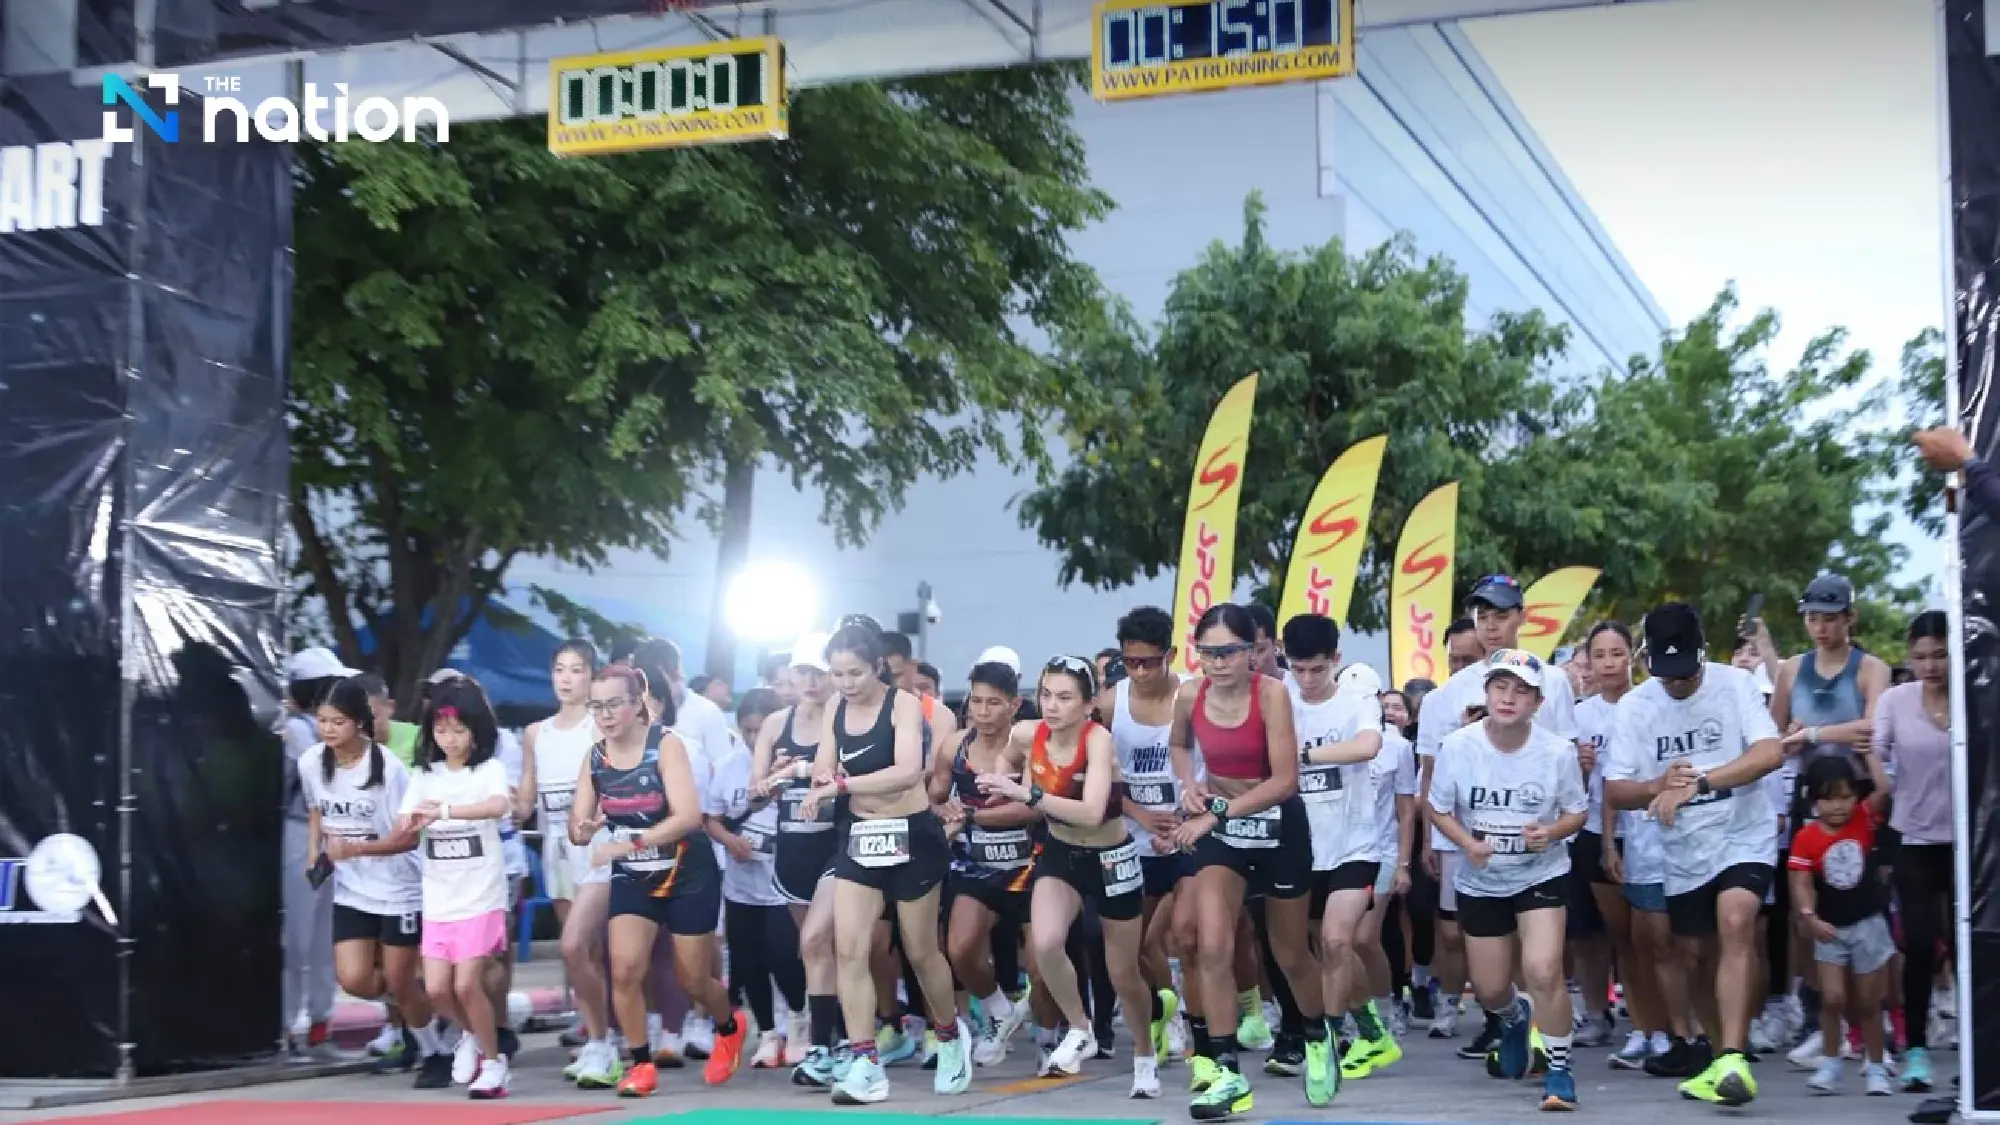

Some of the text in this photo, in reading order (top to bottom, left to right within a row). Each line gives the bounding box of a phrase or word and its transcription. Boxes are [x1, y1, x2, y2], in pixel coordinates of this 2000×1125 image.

[1102, 49, 1340, 89] WWW.PATRUNNING.COM
[1469, 786, 1518, 811] PAT
[859, 833, 896, 855] 0234
